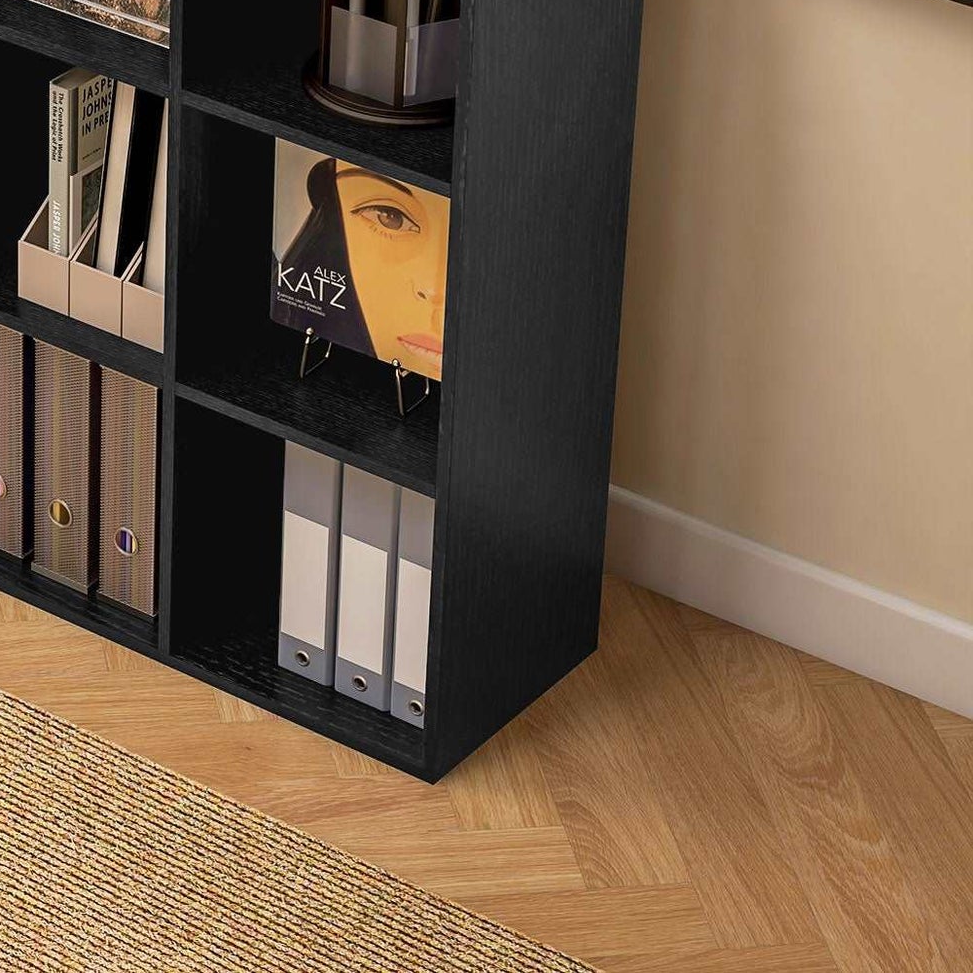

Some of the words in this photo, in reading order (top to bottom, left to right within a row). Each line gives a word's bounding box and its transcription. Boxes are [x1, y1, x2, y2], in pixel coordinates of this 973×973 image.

[82, 121, 91, 137] IN
[52, 137, 58, 145] of
[53, 200, 61, 232] JASPER
[313, 266, 346, 285] ALEX
[278, 262, 346, 310] KATZ
